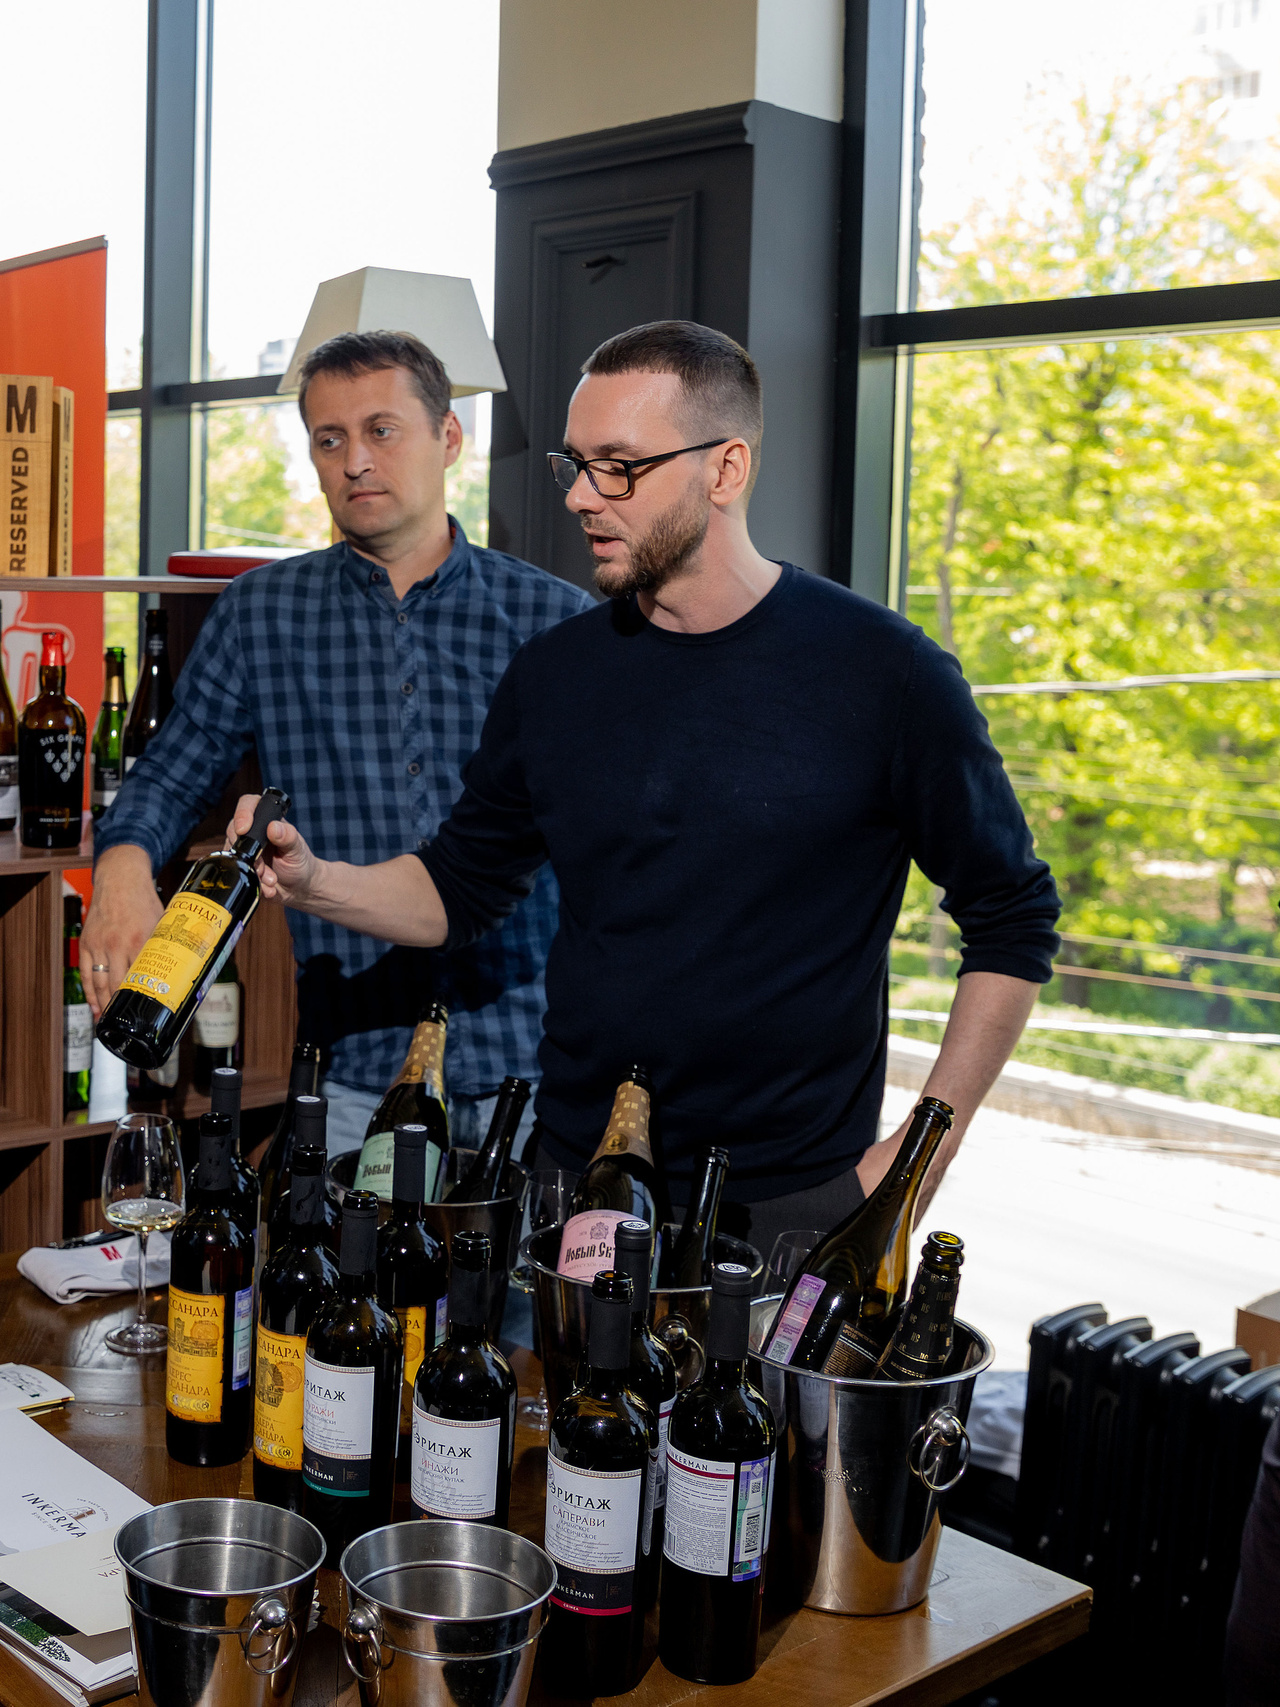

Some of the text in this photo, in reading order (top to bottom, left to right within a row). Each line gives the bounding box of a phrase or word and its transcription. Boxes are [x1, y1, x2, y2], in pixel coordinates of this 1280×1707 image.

[6, 384, 37, 433] M
[9, 446, 29, 572] RESERVED
[40, 736, 55, 746] SIX
[138, 958, 173, 974] КРАСНЫЙ
[141, 951, 178, 968] ПОРТВЕЙН
[565, 1242, 615, 1264] Новый Св
[414, 1432, 472, 1458] ЭРИТАЖ
[421, 1458, 459, 1475] ИНДЖИ
[549, 1482, 611, 1511] ЭРИТАЖ
[21, 1492, 87, 1538] INKERMA
[552, 1505, 606, 1528] САПЕРАВИ
[555, 1582, 595, 1600] NKERMAN
